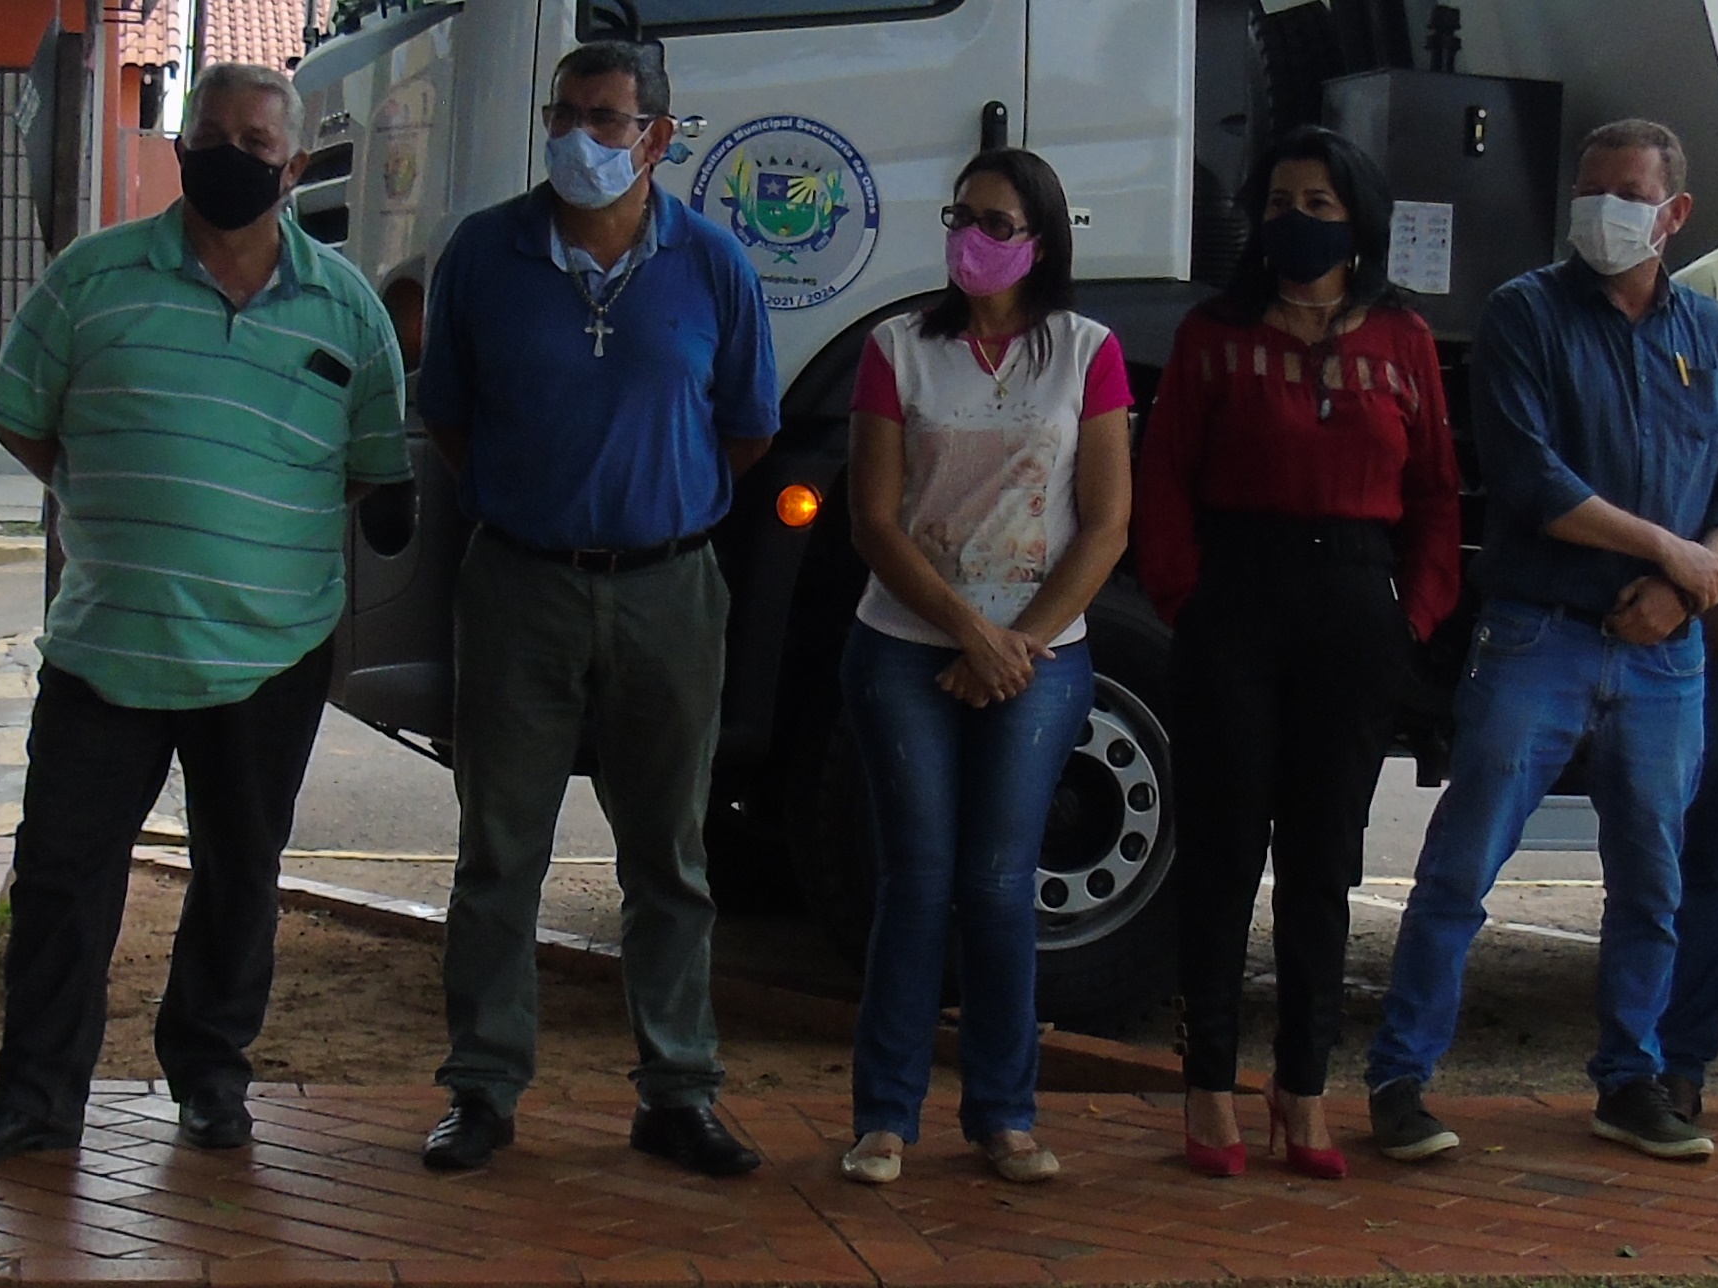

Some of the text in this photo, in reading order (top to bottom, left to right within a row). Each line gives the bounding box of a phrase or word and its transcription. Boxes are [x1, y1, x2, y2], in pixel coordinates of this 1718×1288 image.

[693, 117, 877, 215] Prefeitura Municipal Secretaria de Obras
[765, 295, 794, 306] 2021
[807, 285, 837, 303] 2024
